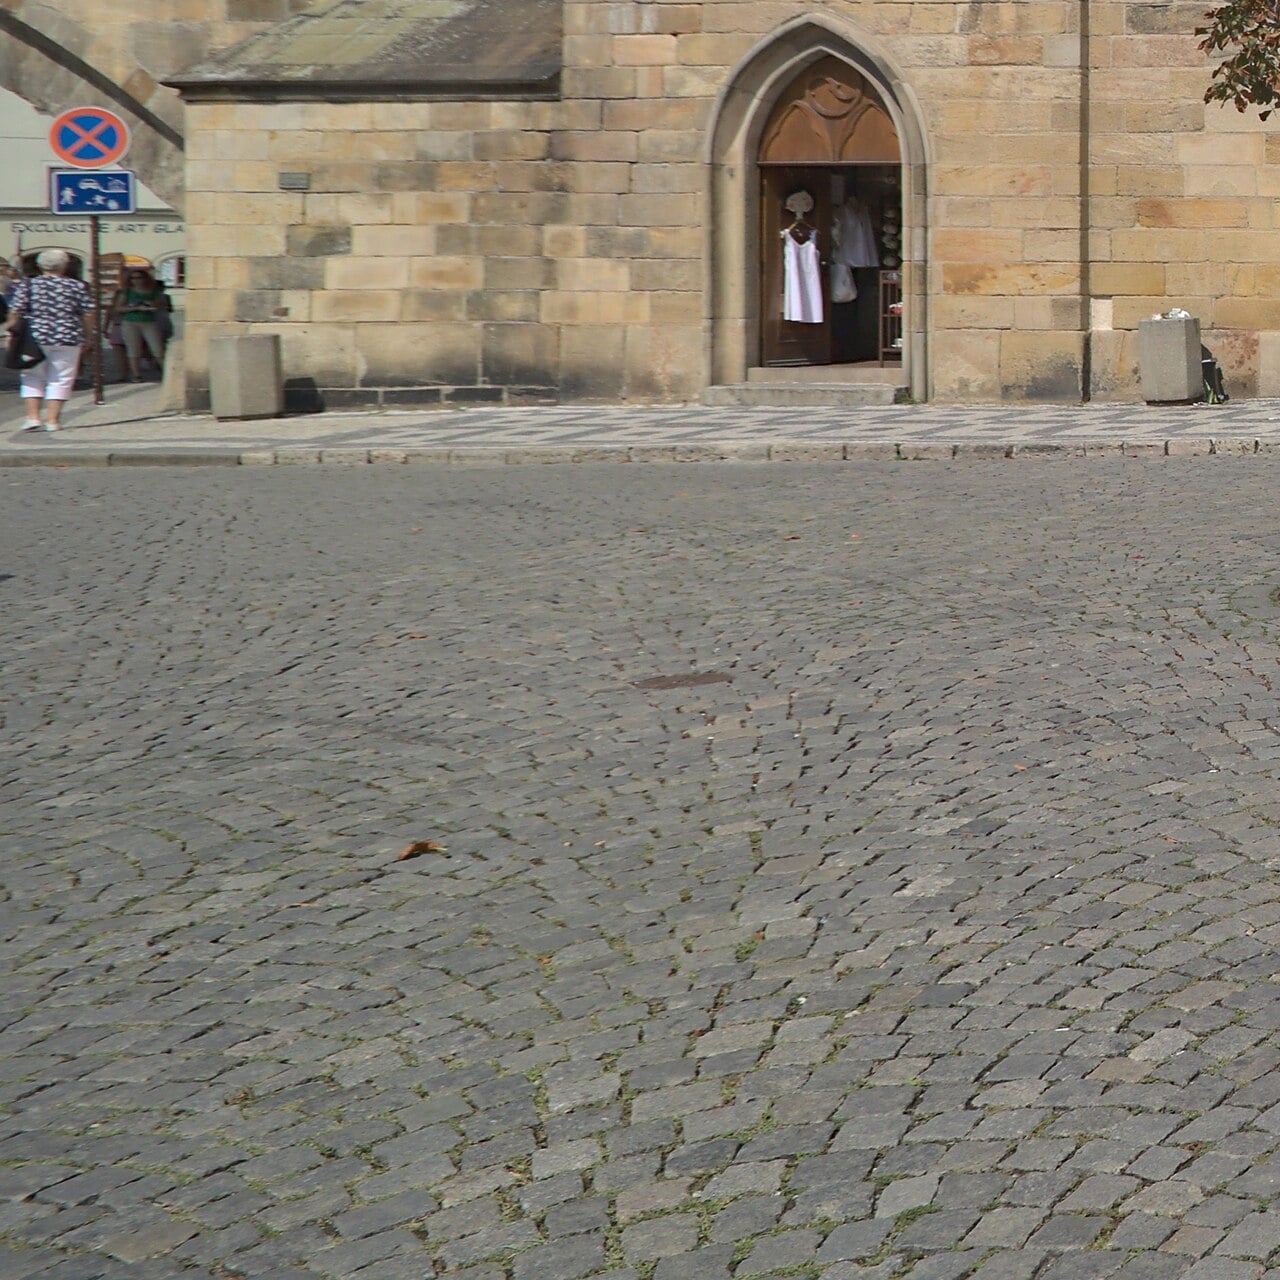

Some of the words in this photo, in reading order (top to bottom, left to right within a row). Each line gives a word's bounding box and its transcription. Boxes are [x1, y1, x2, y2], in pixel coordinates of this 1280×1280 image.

[12, 223, 109, 233] EXCLUSIE
[117, 223, 148, 233] ART
[153, 224, 184, 234] GLA
